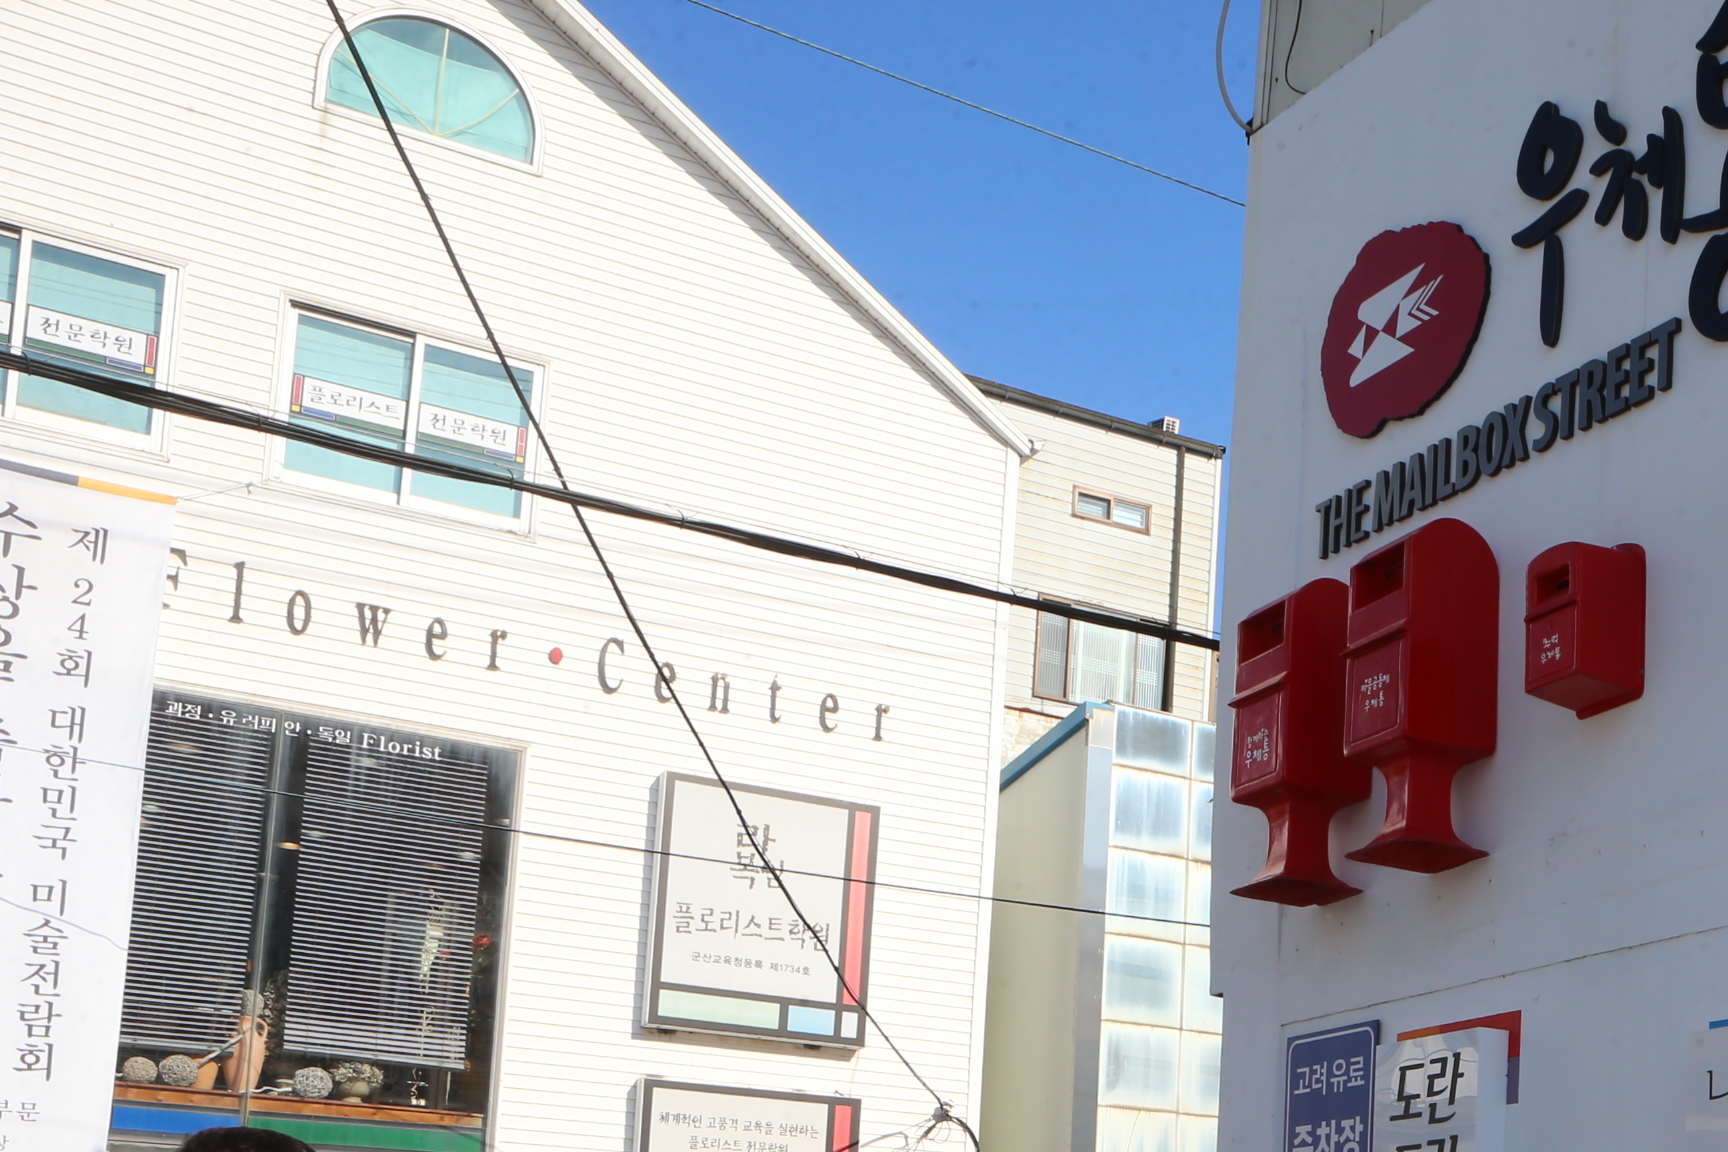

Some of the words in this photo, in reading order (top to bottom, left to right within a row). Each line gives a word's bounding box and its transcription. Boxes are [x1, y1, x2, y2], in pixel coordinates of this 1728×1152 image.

[39, 315, 134, 356] 전문학원
[306, 383, 402, 421] 플로리스트
[428, 412, 509, 448] 전문학원
[1315, 478, 1372, 561] THE
[1371, 394, 1535, 534] MAILBOX
[1531, 316, 1683, 454] STREET
[52, 526, 110, 690] 제24회
[1540, 646, 1561, 665] 우체통
[597, 635, 891, 742] Center
[1364, 690, 1385, 713] 우체통
[164, 700, 202, 722] 과정
[317, 725, 352, 746] 독일
[360, 733, 443, 762] Florist
[1244, 735, 1270, 769] 우체통
[32, 704, 87, 862] 대한민국
[12, 878, 69, 1083] 미술전람회
[690, 950, 764, 970] 군산교육청등록
[769, 962, 812, 976] 제1734호
[1293, 1061, 1328, 1096] 고려
[1330, 1056, 1365, 1092] 유료
[1389, 1052, 1465, 1125] 도란
[658, 1111, 703, 1129] 체계적인
[706, 1116, 740, 1132] 고풍격
[742, 1119, 775, 1136] 교육을
[778, 1122, 820, 1140] 실현하는
[688, 1135, 743, 1152] 플로리스트
